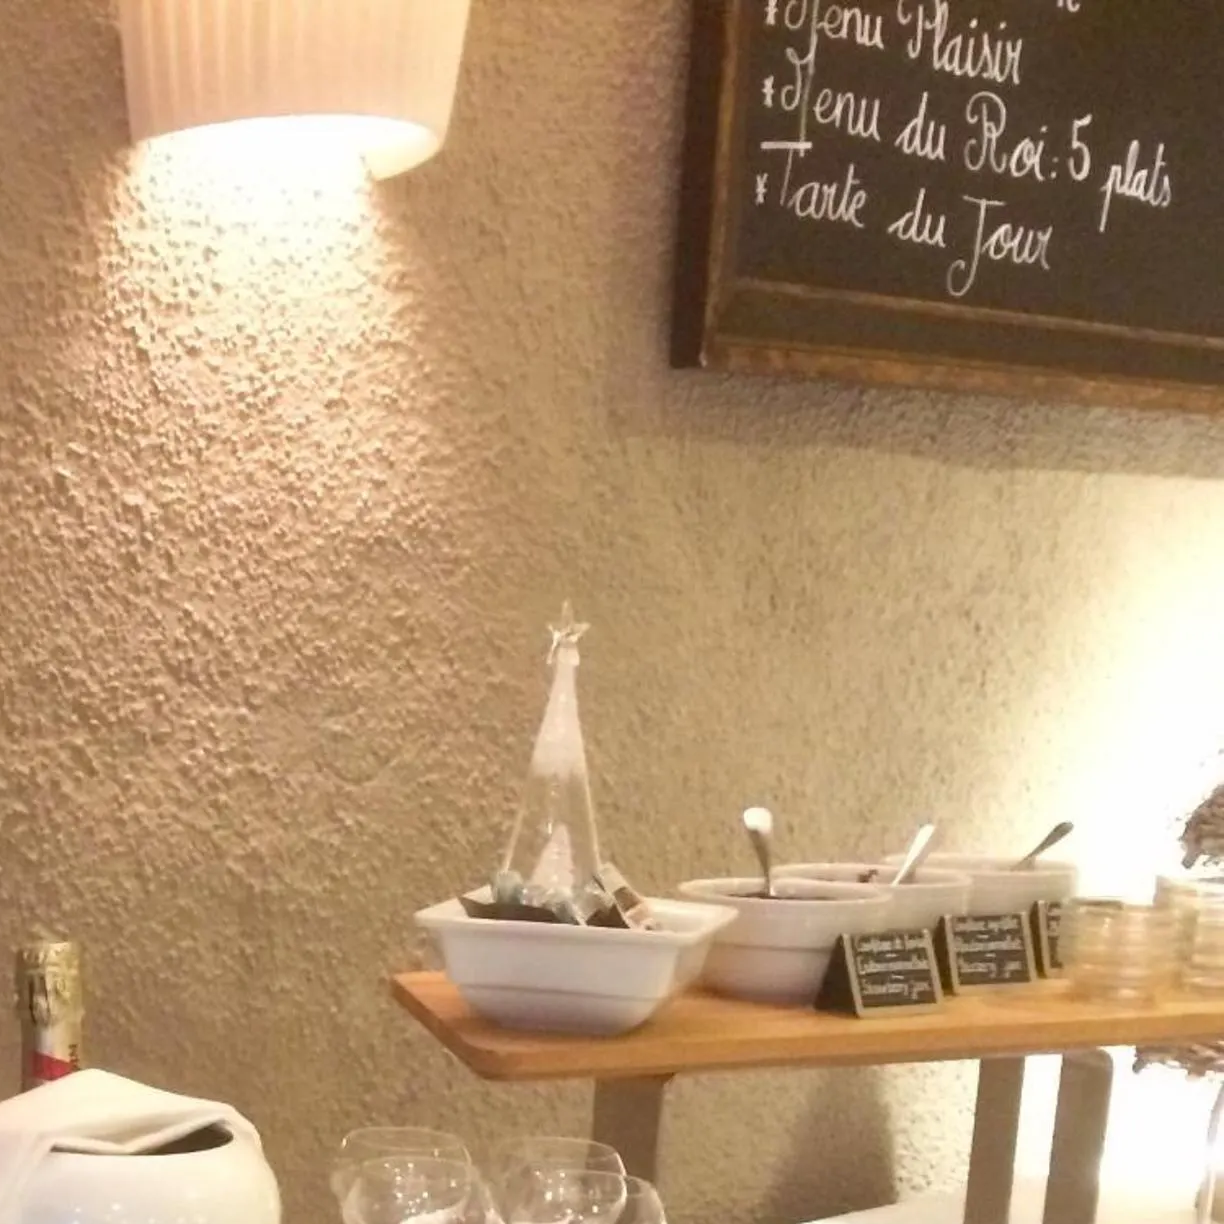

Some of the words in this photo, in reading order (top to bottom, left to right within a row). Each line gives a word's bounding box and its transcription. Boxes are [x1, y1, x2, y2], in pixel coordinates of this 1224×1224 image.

[760, 141, 865, 228] Tarte
[887, 187, 946, 249] du
[946, 194, 1053, 297] Jour
[894, 92, 945, 161] du
[1067, 113, 1094, 181] 5
[1100, 139, 1172, 233] plats
